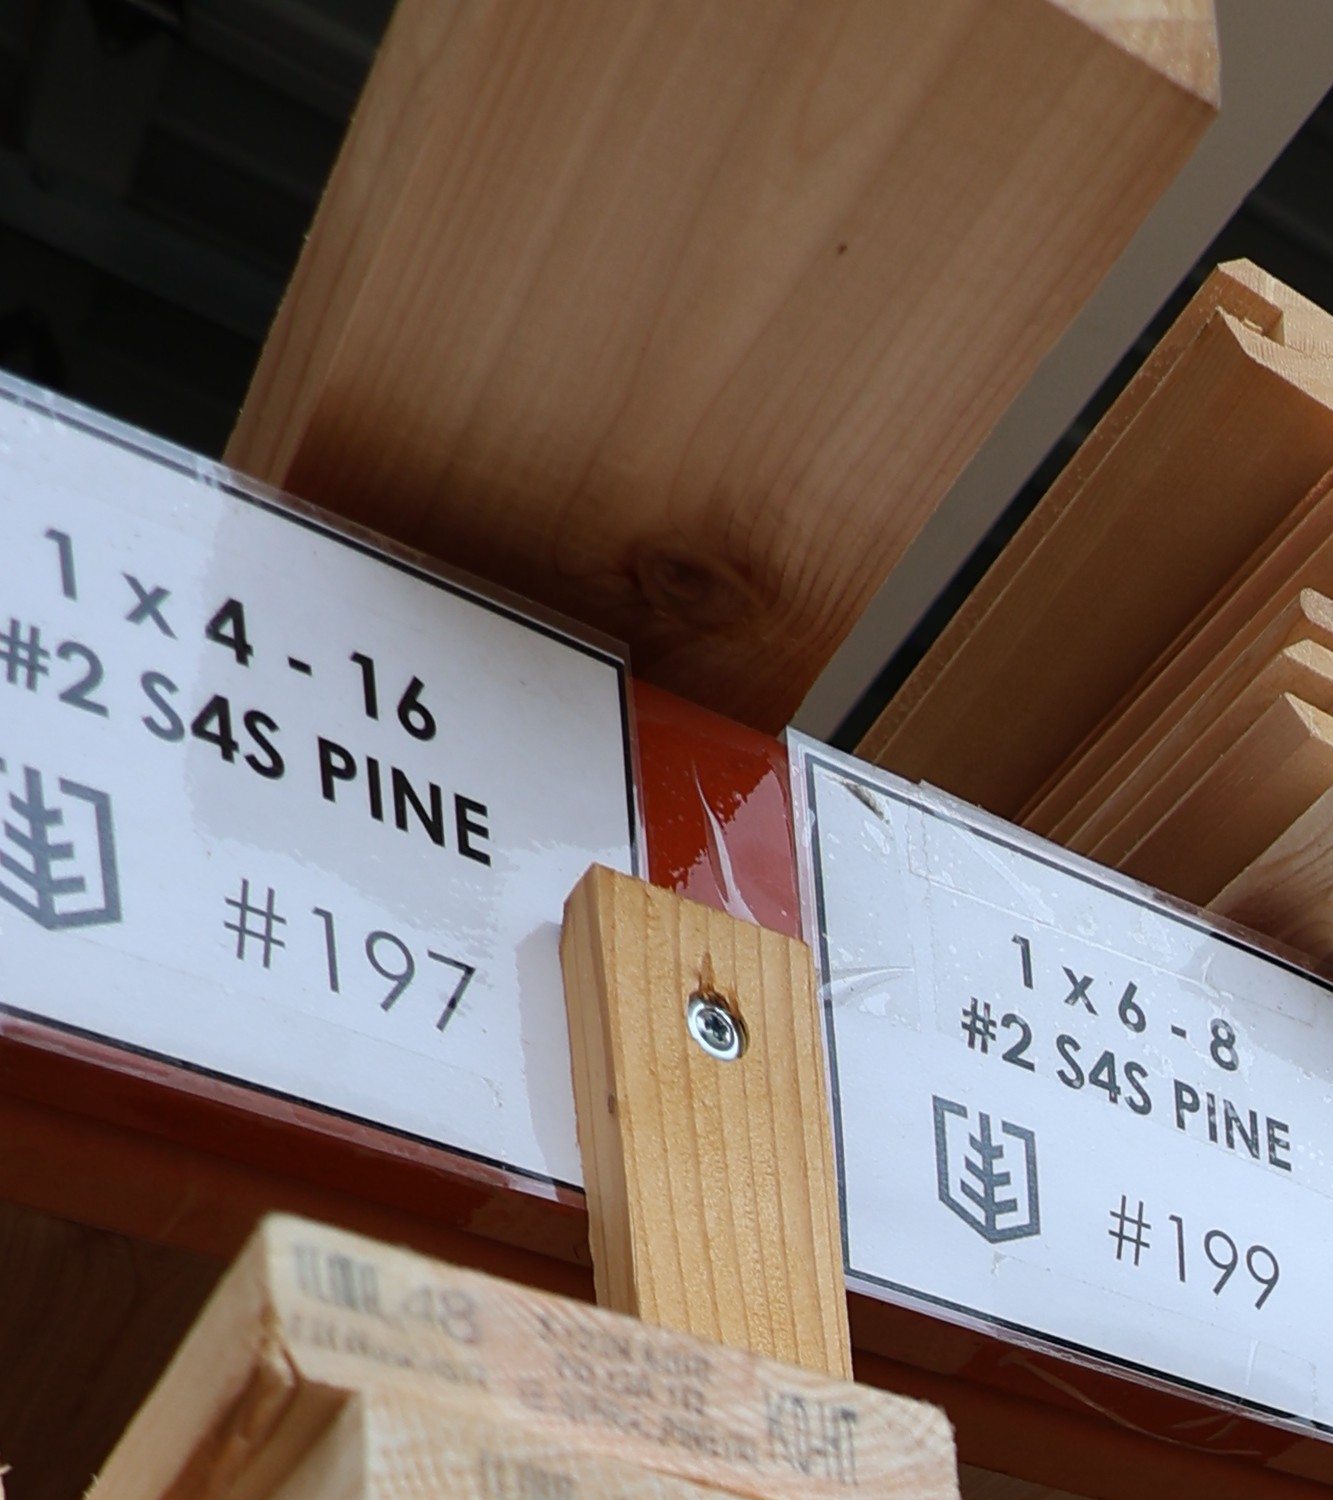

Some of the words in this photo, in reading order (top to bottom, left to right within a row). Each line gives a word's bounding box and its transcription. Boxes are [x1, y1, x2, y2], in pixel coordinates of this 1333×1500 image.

[43, 527, 79, 601] 1
[121, 572, 177, 639] x
[205, 597, 255, 669] 4
[350, 651, 438, 742] 16
[0, 618, 110, 717] #2
[140, 670, 286, 781] S4S
[316, 735, 494, 869] PINE
[223, 876, 477, 1035] #197
[1011, 933, 1036, 991] 1
[1062, 966, 1098, 1015] x
[1118, 979, 1148, 1034] 6
[1209, 1017, 1241, 1072] 8
[961, 997, 1037, 1073] #2
[1056, 1031, 1152, 1117] S4S
[1172, 1078, 1294, 1172] PINE
[1108, 1194, 1281, 1310] #199
